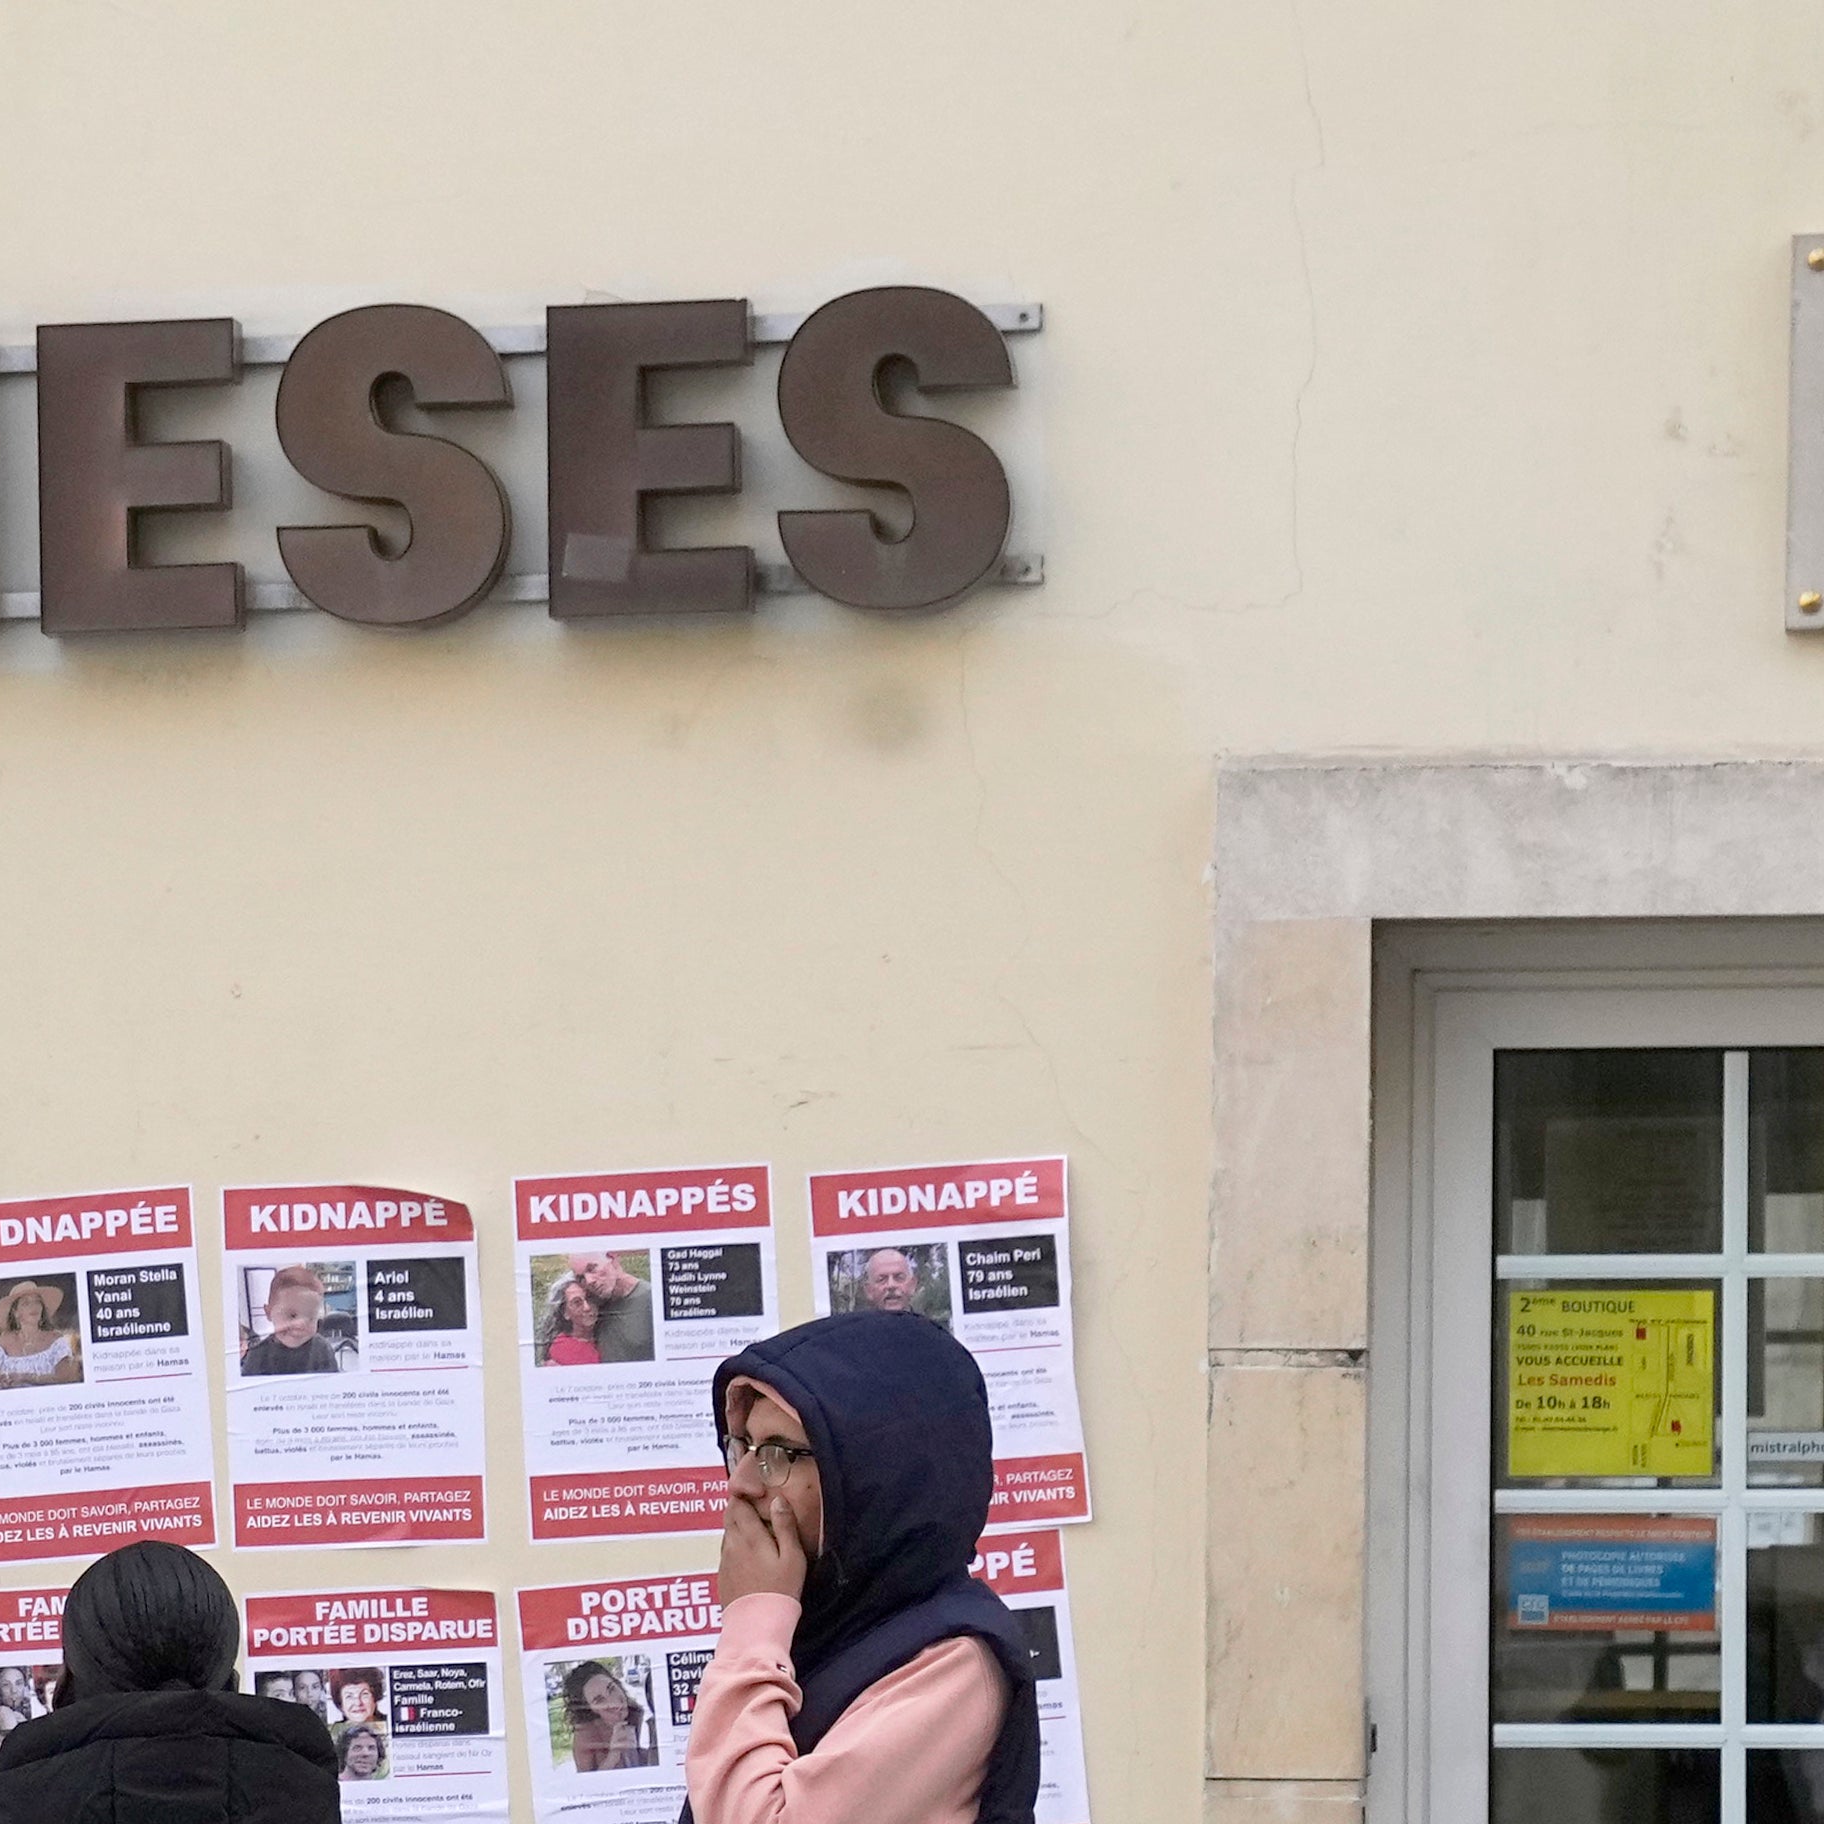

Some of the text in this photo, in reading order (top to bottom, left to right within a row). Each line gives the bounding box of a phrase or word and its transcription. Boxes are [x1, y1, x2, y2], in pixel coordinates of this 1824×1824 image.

[530, 1179, 756, 1223] KIDNAPPÉS
[838, 1170, 1038, 1218] KIDNAPPÉ
[250, 1199, 447, 1232] KIDNAPPÉ
[966, 1248, 1040, 1265] Chaim Peri
[375, 1270, 408, 1284] Ariel
[968, 1270, 1012, 1282] 79 ans
[375, 1290, 414, 1302] 4 ans
[1562, 1300, 1634, 1314] BOUTIQUE
[1517, 1325, 1536, 1336] 40
[1516, 1356, 1622, 1366] VOUS ACCUEILLE
[1518, 1374, 1616, 1386] Les Samedis
[1516, 1400, 1531, 1409] De
[1538, 1396, 1565, 1409] 10h
[1582, 1396, 1610, 1408] 18h
[581, 1580, 712, 1614] PORTÉE
[316, 1598, 428, 1620] FAMILLE
[253, 1618, 494, 1648] PORTÉE DISPARUE
